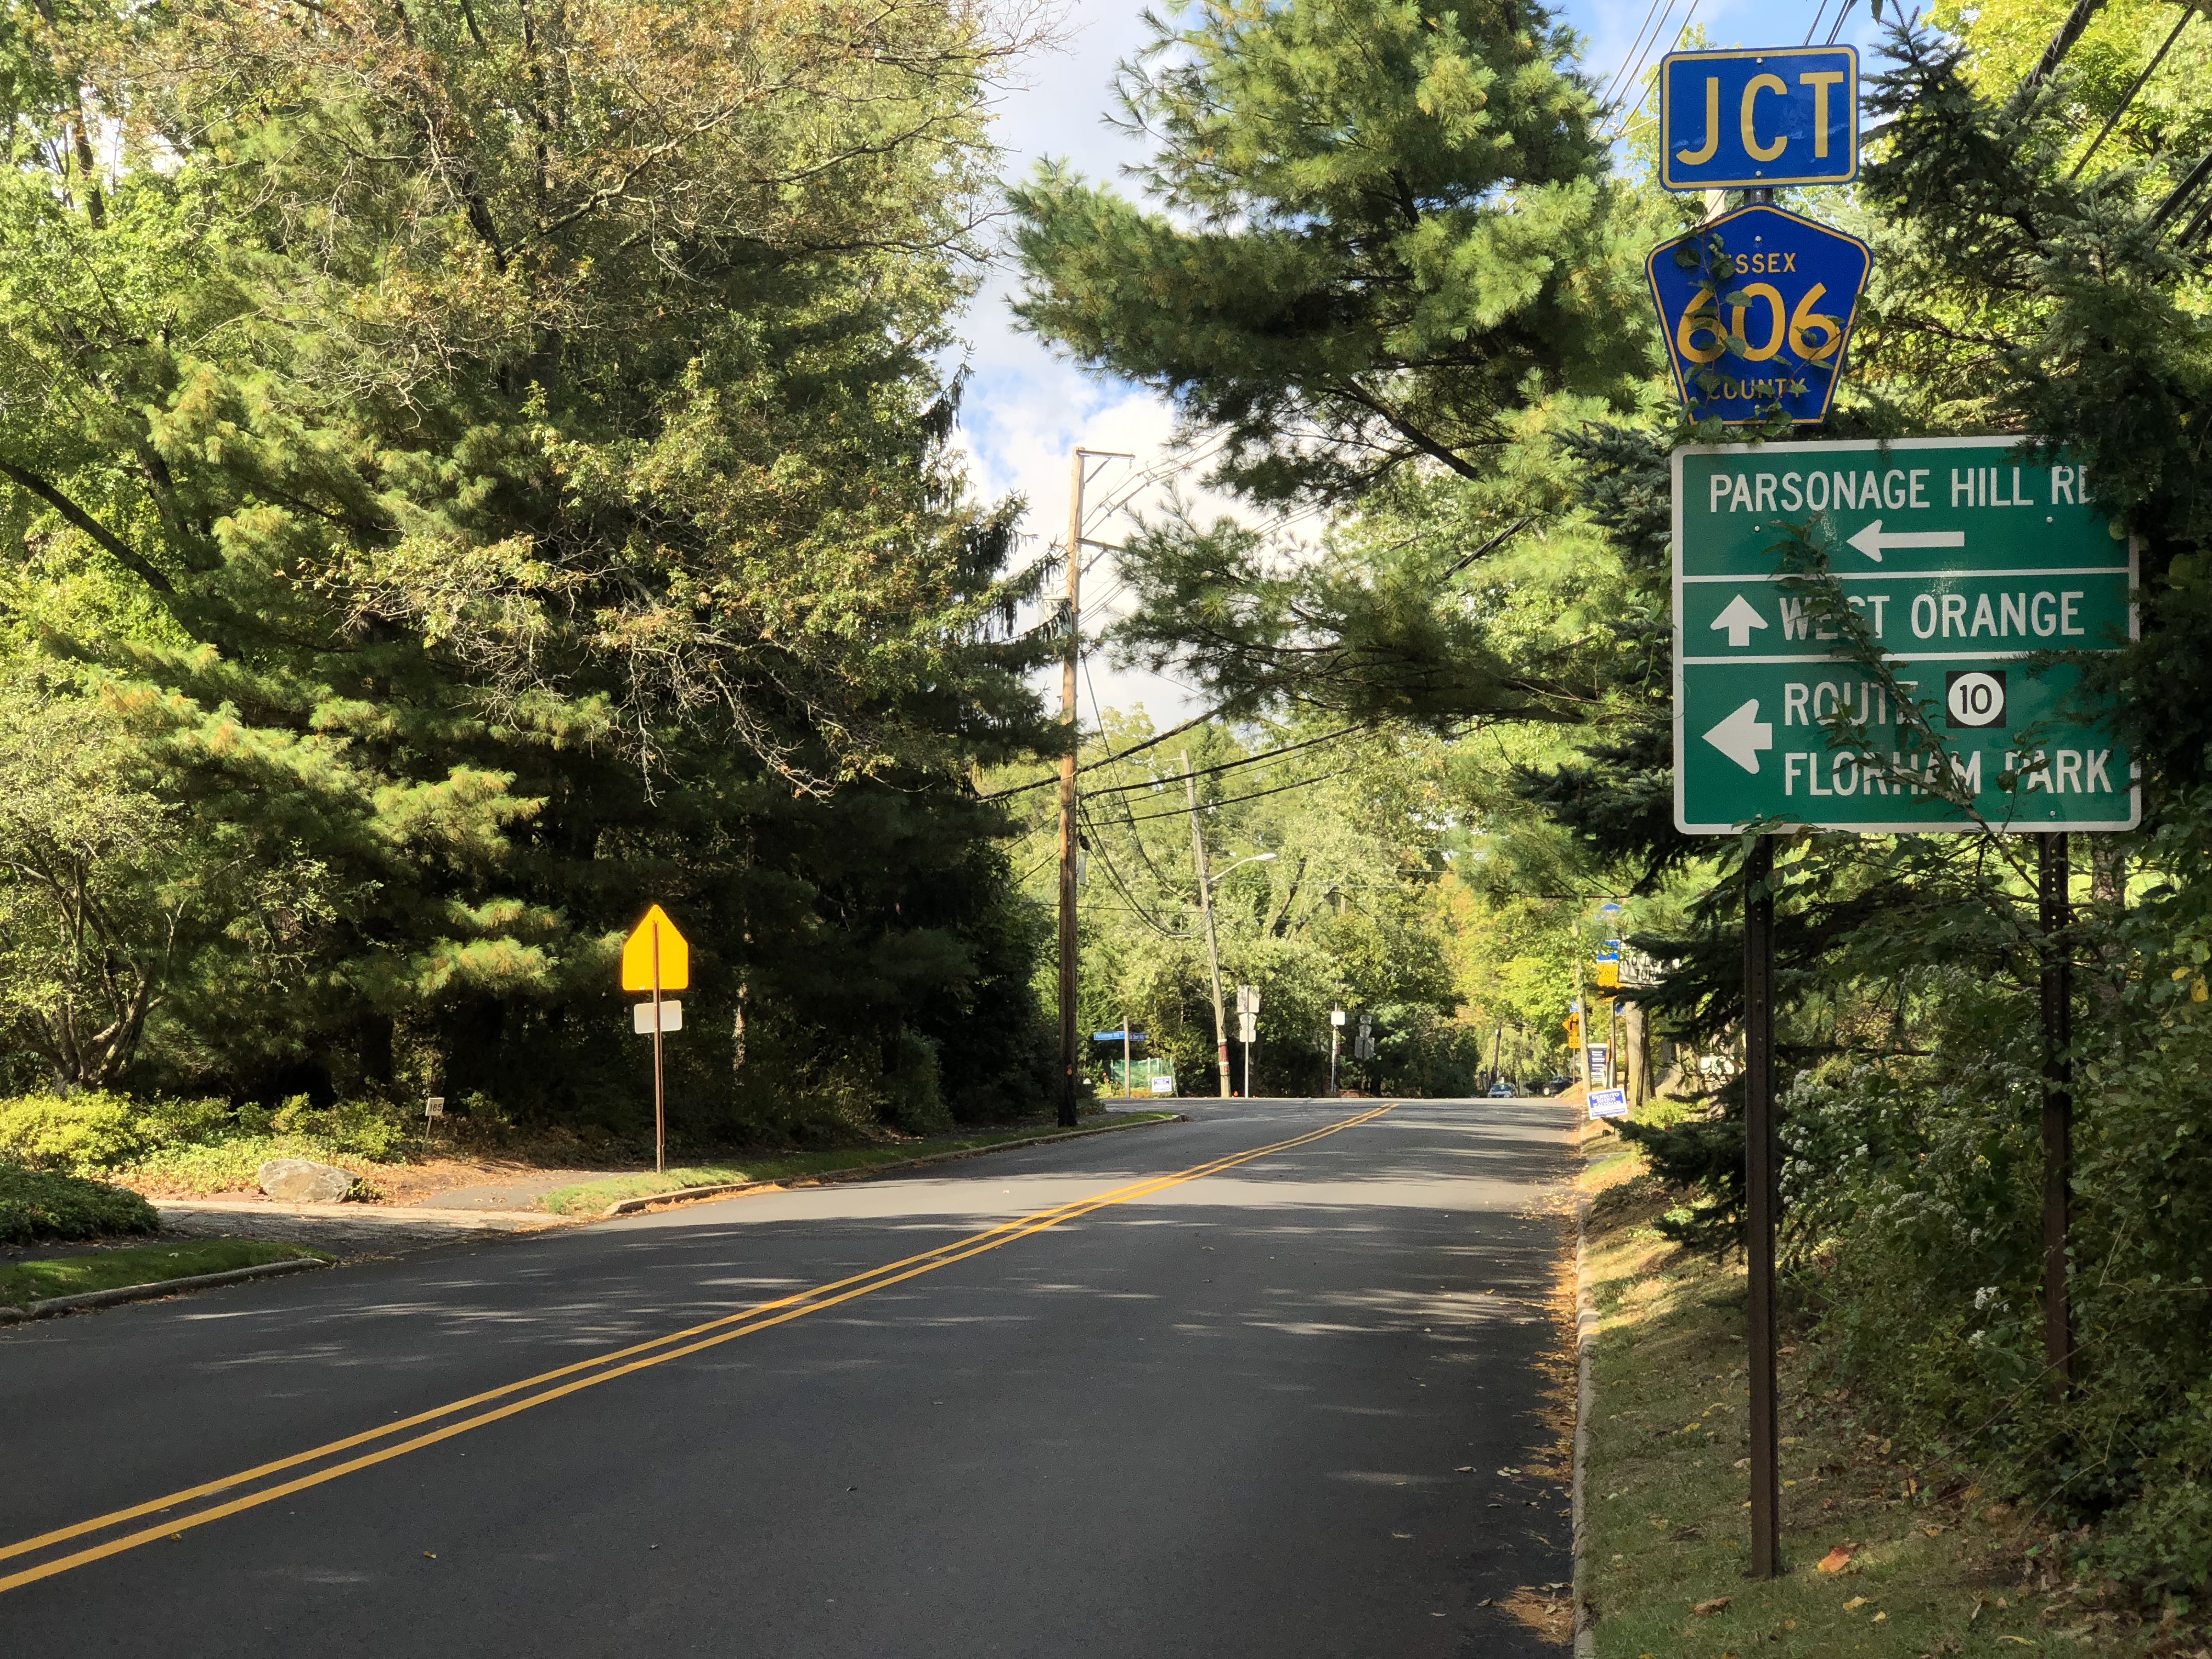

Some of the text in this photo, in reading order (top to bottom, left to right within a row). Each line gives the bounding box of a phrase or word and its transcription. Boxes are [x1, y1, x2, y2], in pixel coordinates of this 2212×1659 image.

[1676, 71, 1844, 165] JCT
[1724, 252, 1796, 274] SSEX
[1677, 282, 1842, 363] 606
[1710, 469, 1931, 512] PARSONAGE
[1951, 466, 2034, 507] HILL
[1911, 591, 2085, 639] ORANGE
[1960, 684, 1992, 715] 10
[430, 1103, 442, 1112] 165
